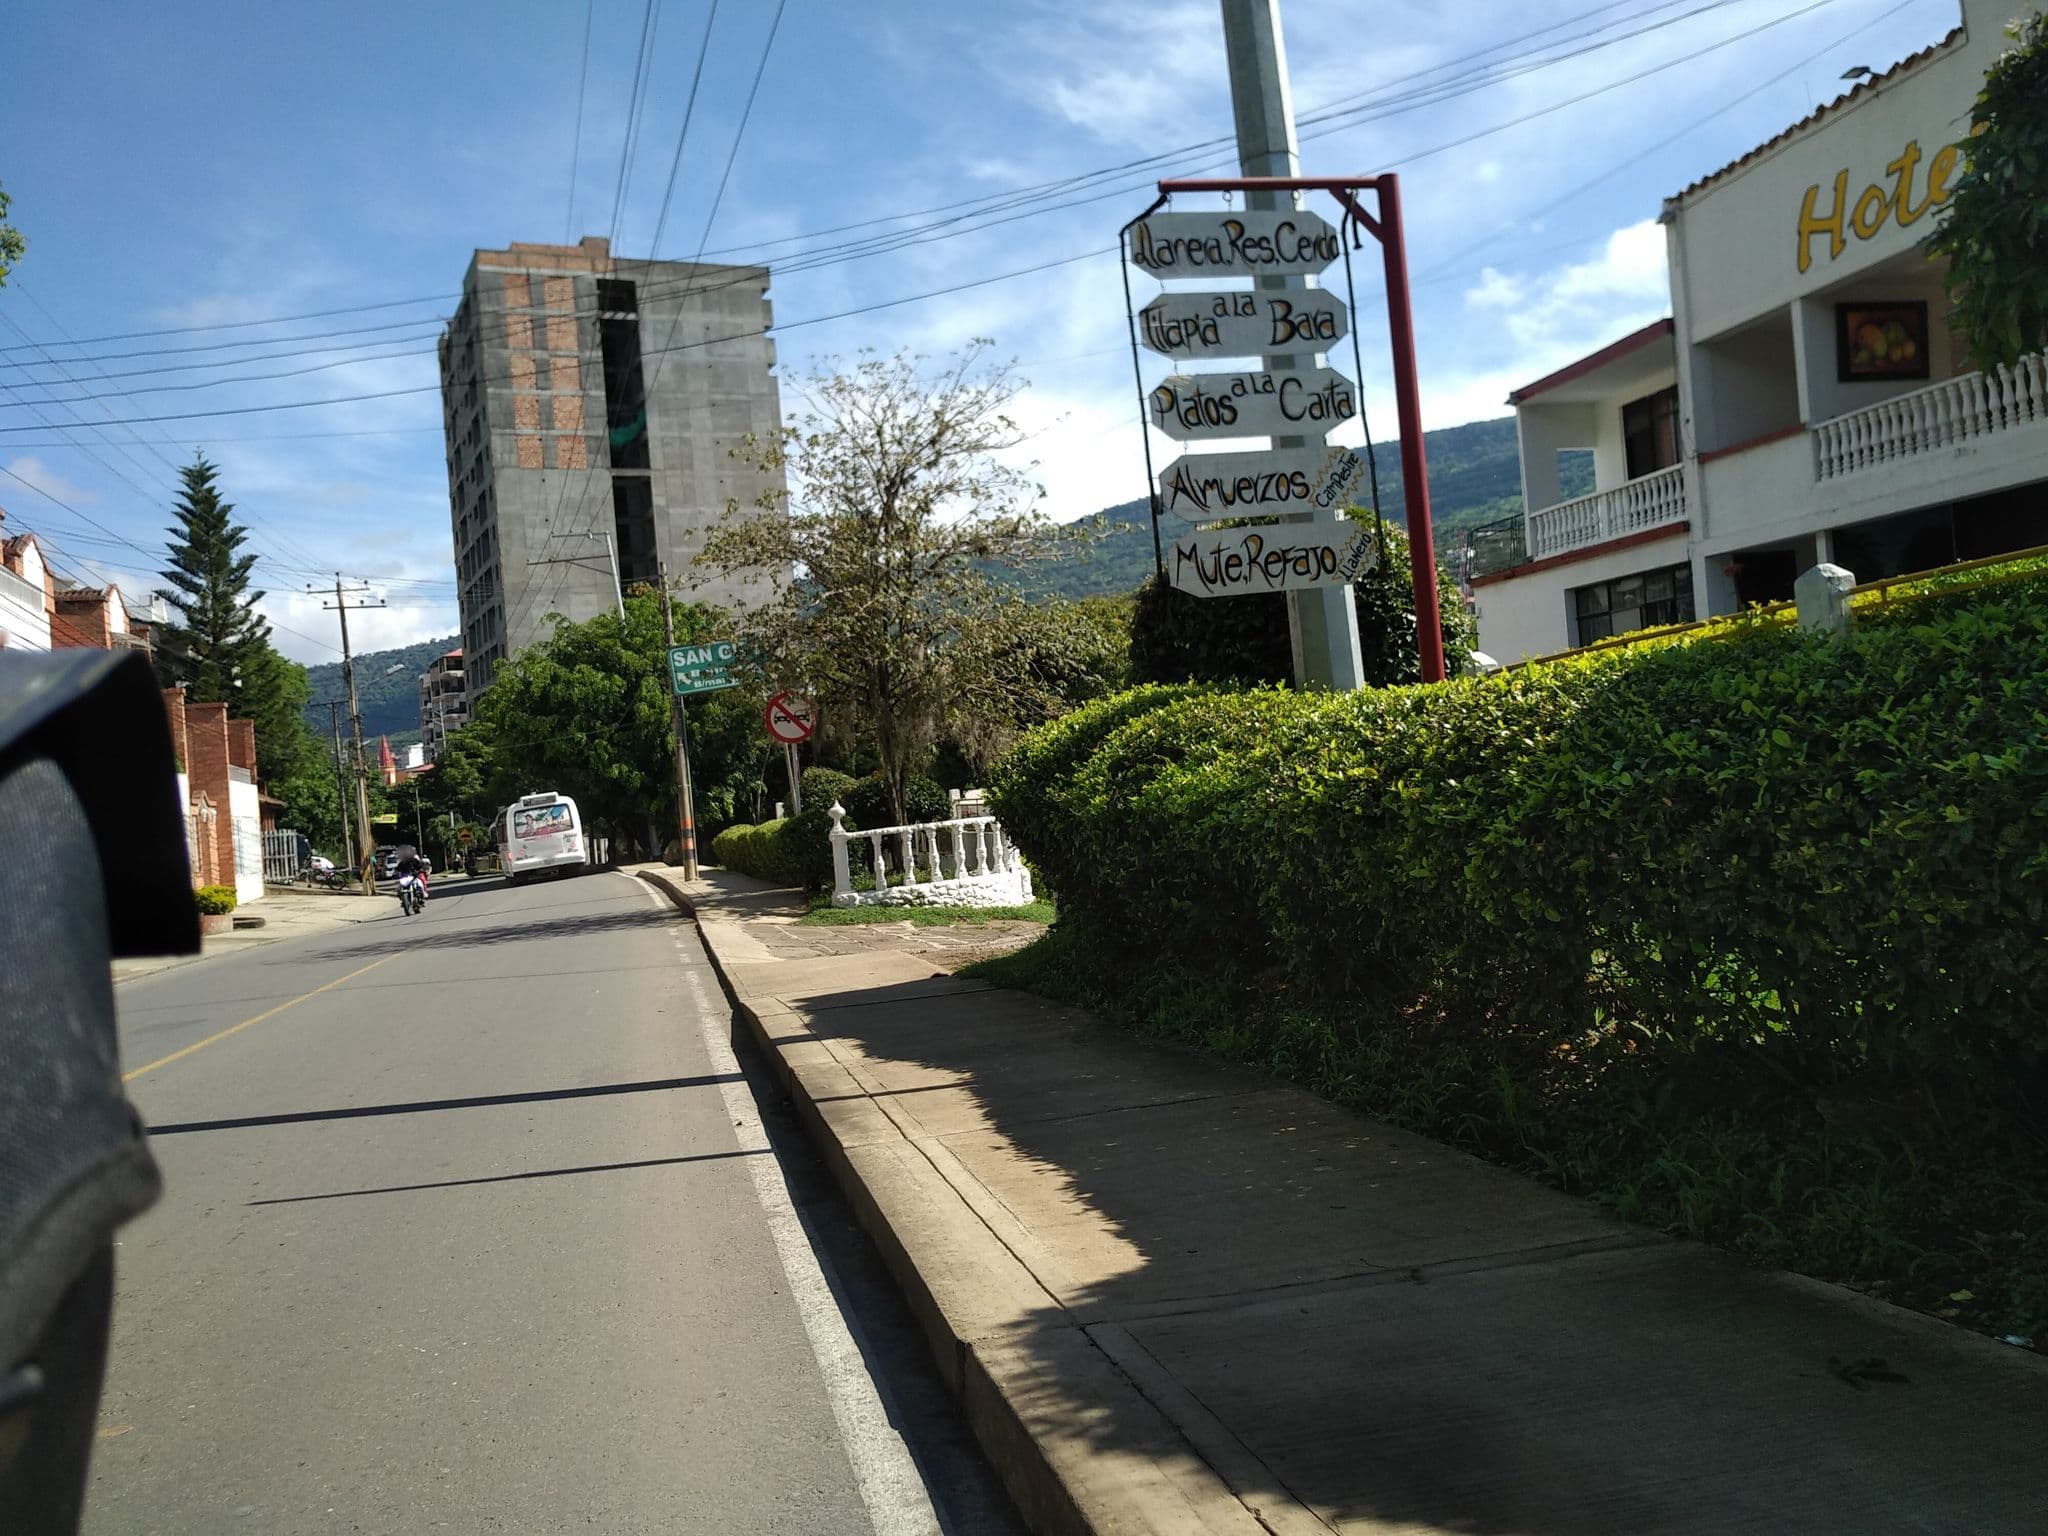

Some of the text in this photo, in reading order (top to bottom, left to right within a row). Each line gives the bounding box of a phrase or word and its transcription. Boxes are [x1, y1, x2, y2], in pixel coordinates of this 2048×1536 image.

[1797, 120, 1991, 274] Hote
[1153, 385, 1238, 431] Platos
[1279, 377, 1356, 421] Carta
[1167, 464, 1311, 512] Almuerzos
[673, 647, 713, 667] SAN
